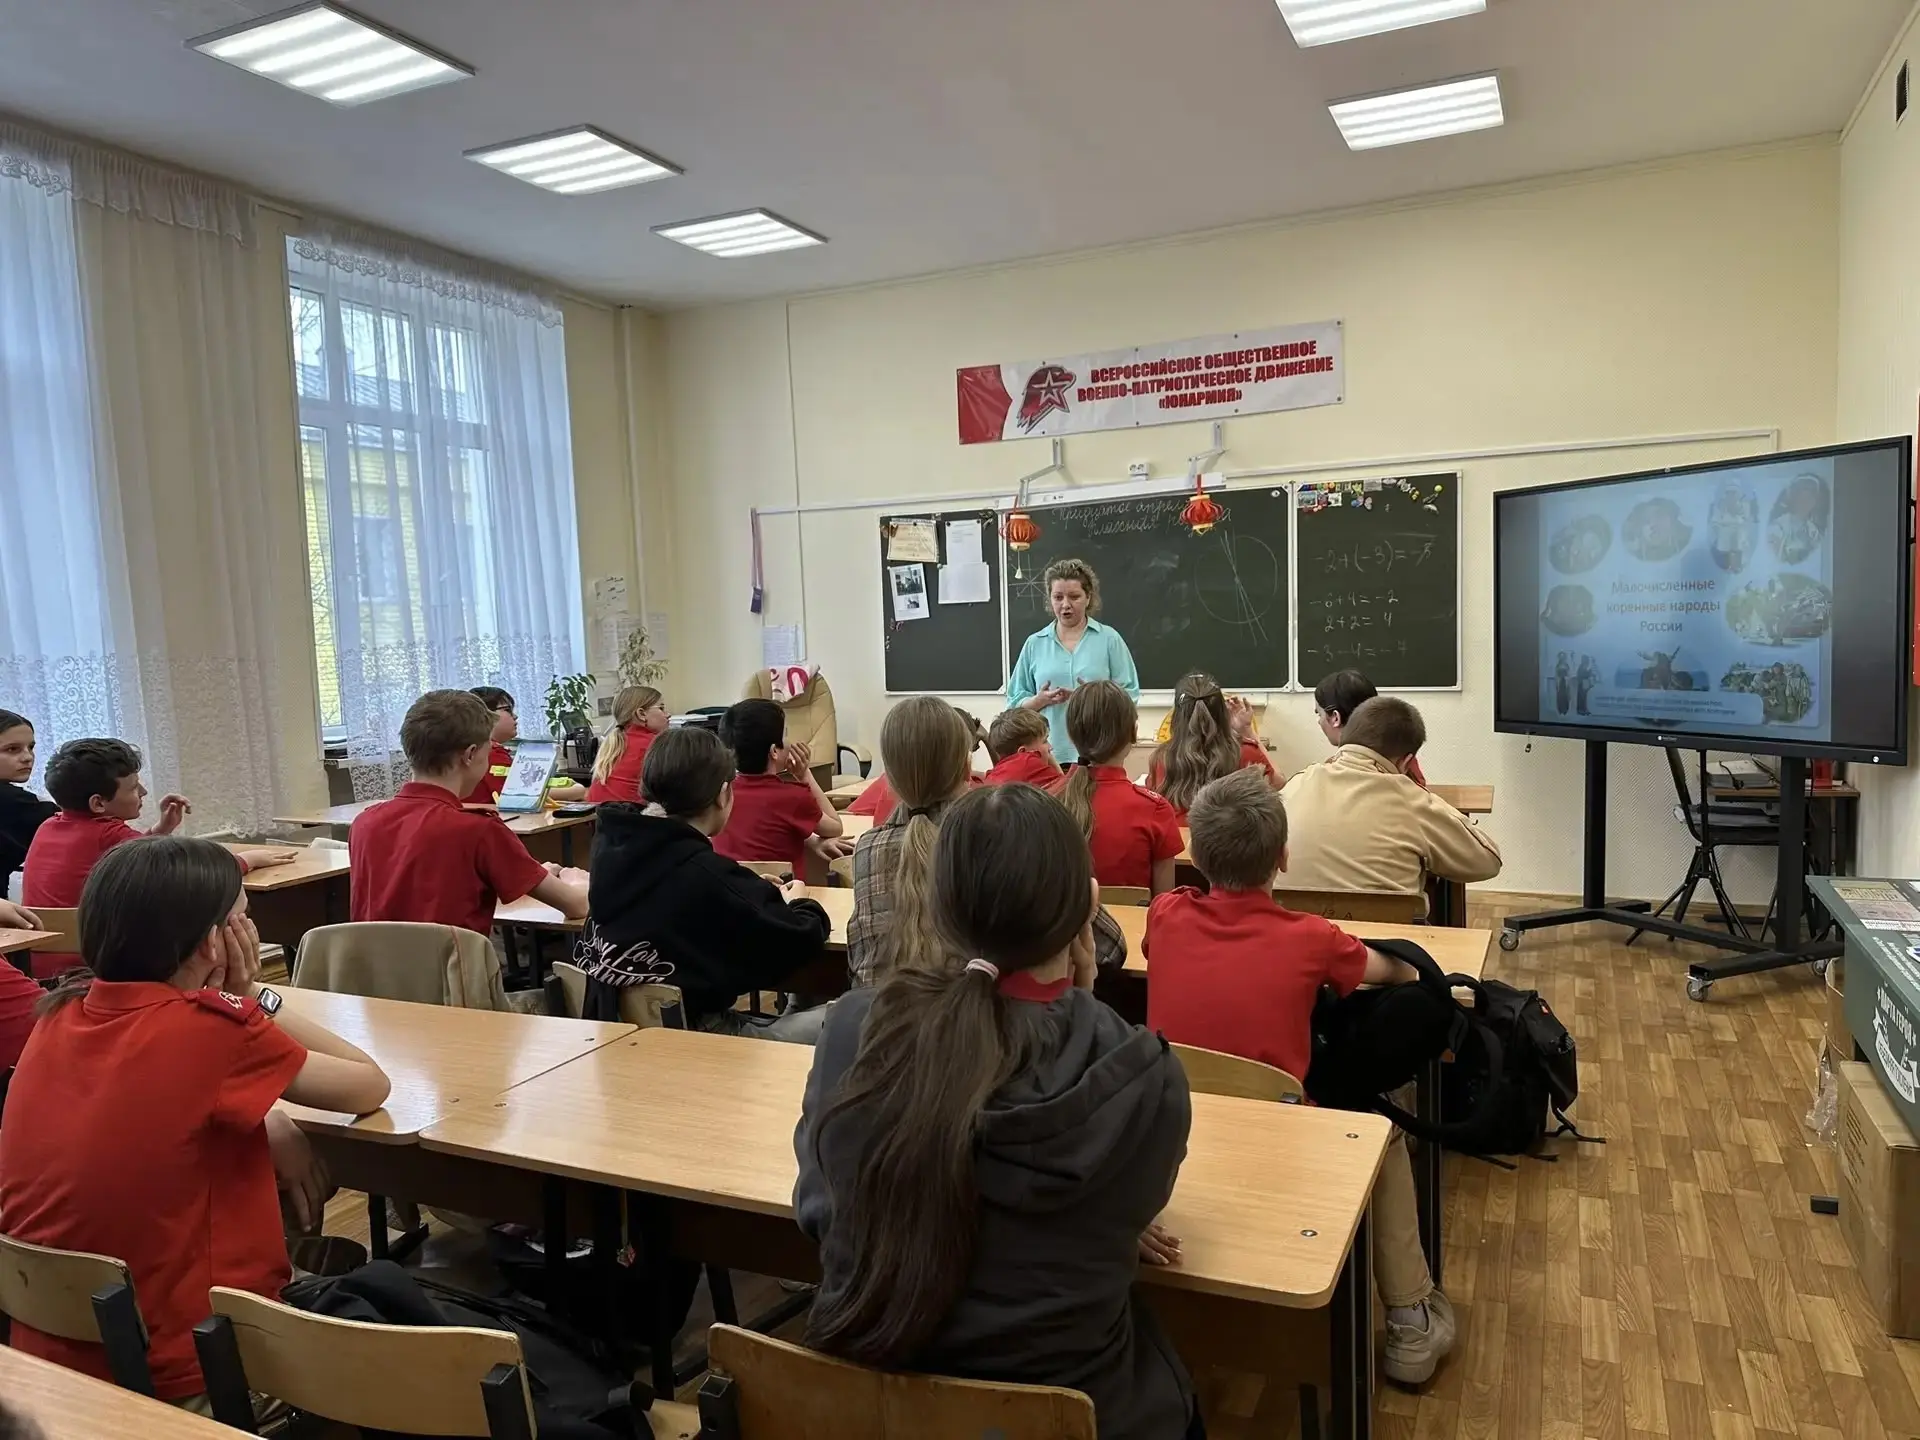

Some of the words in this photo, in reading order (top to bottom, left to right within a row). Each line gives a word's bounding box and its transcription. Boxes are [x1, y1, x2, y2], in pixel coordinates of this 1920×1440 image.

[1091, 356, 1202, 383] ВСЕРОССИЙСКОЕ
[1204, 340, 1317, 370] ОБЩЕСТВЕННОЕ
[1077, 367, 1252, 402] ВОЕННО-ПАТРИОТИЧЕСКОЕ
[1254, 356, 1334, 383] ДВИЖЕНИЕ
[1159, 388, 1242, 409] «ЮНАРМИЯ»
[1611, 578, 1716, 595] Малочисленные
[1606, 602, 1666, 614] коренные
[1669, 600, 1721, 613] народы
[1640, 620, 1683, 632] России
